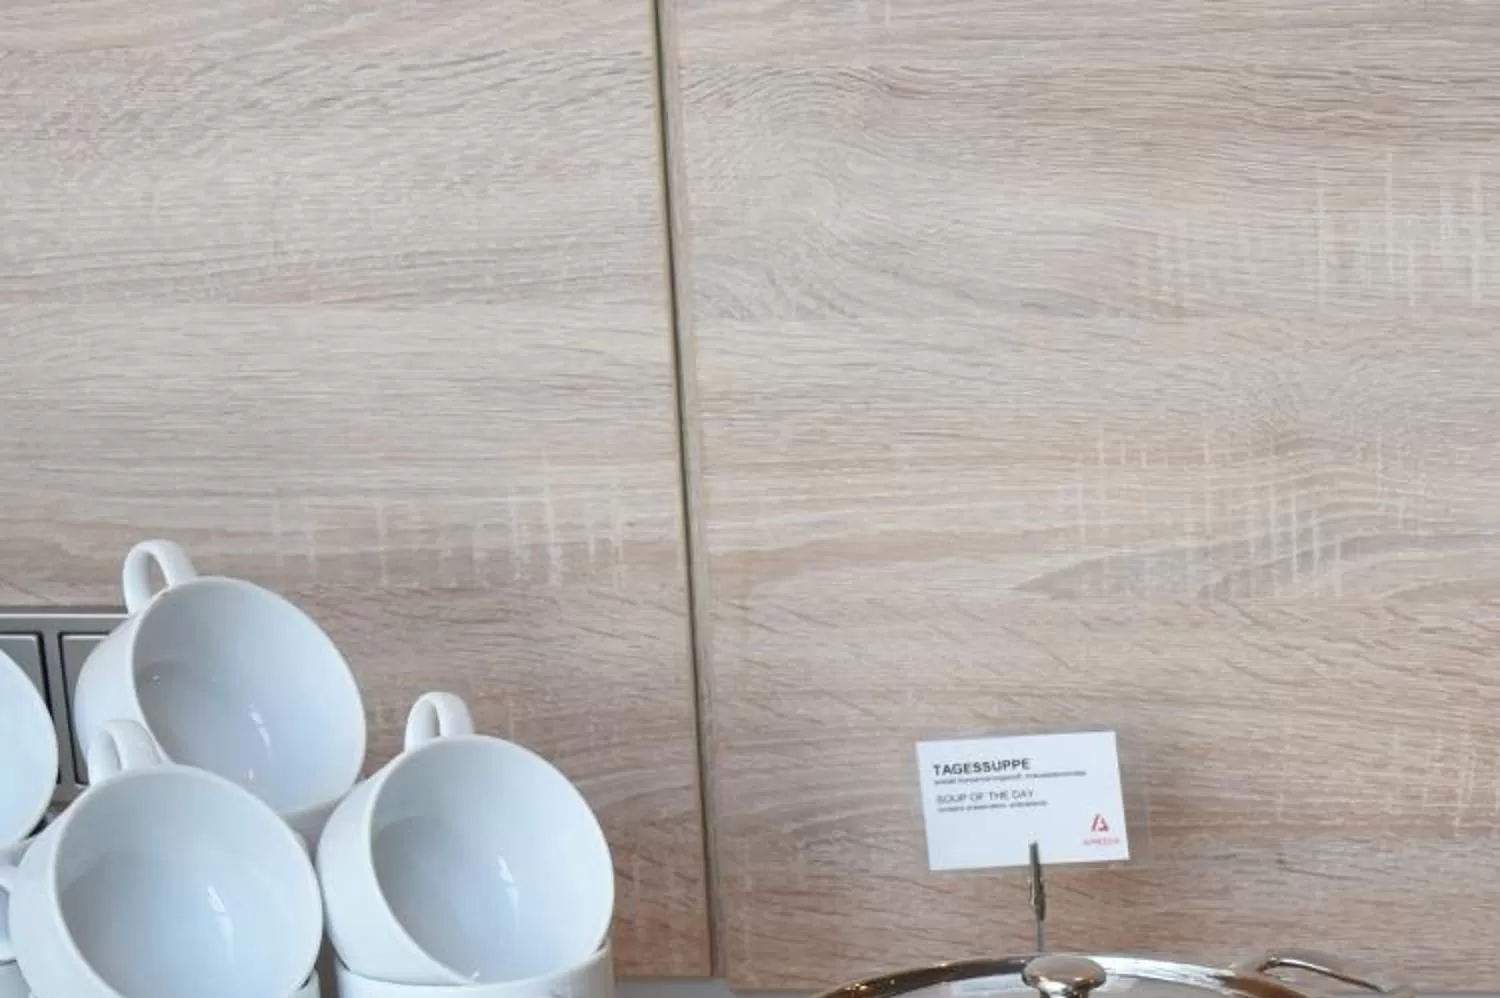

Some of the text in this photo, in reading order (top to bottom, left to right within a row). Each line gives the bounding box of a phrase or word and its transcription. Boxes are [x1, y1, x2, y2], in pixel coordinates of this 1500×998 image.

[933, 758, 1031, 776] TAGESSUPPE
[936, 789, 1035, 804] SOUP OF THE DAY
